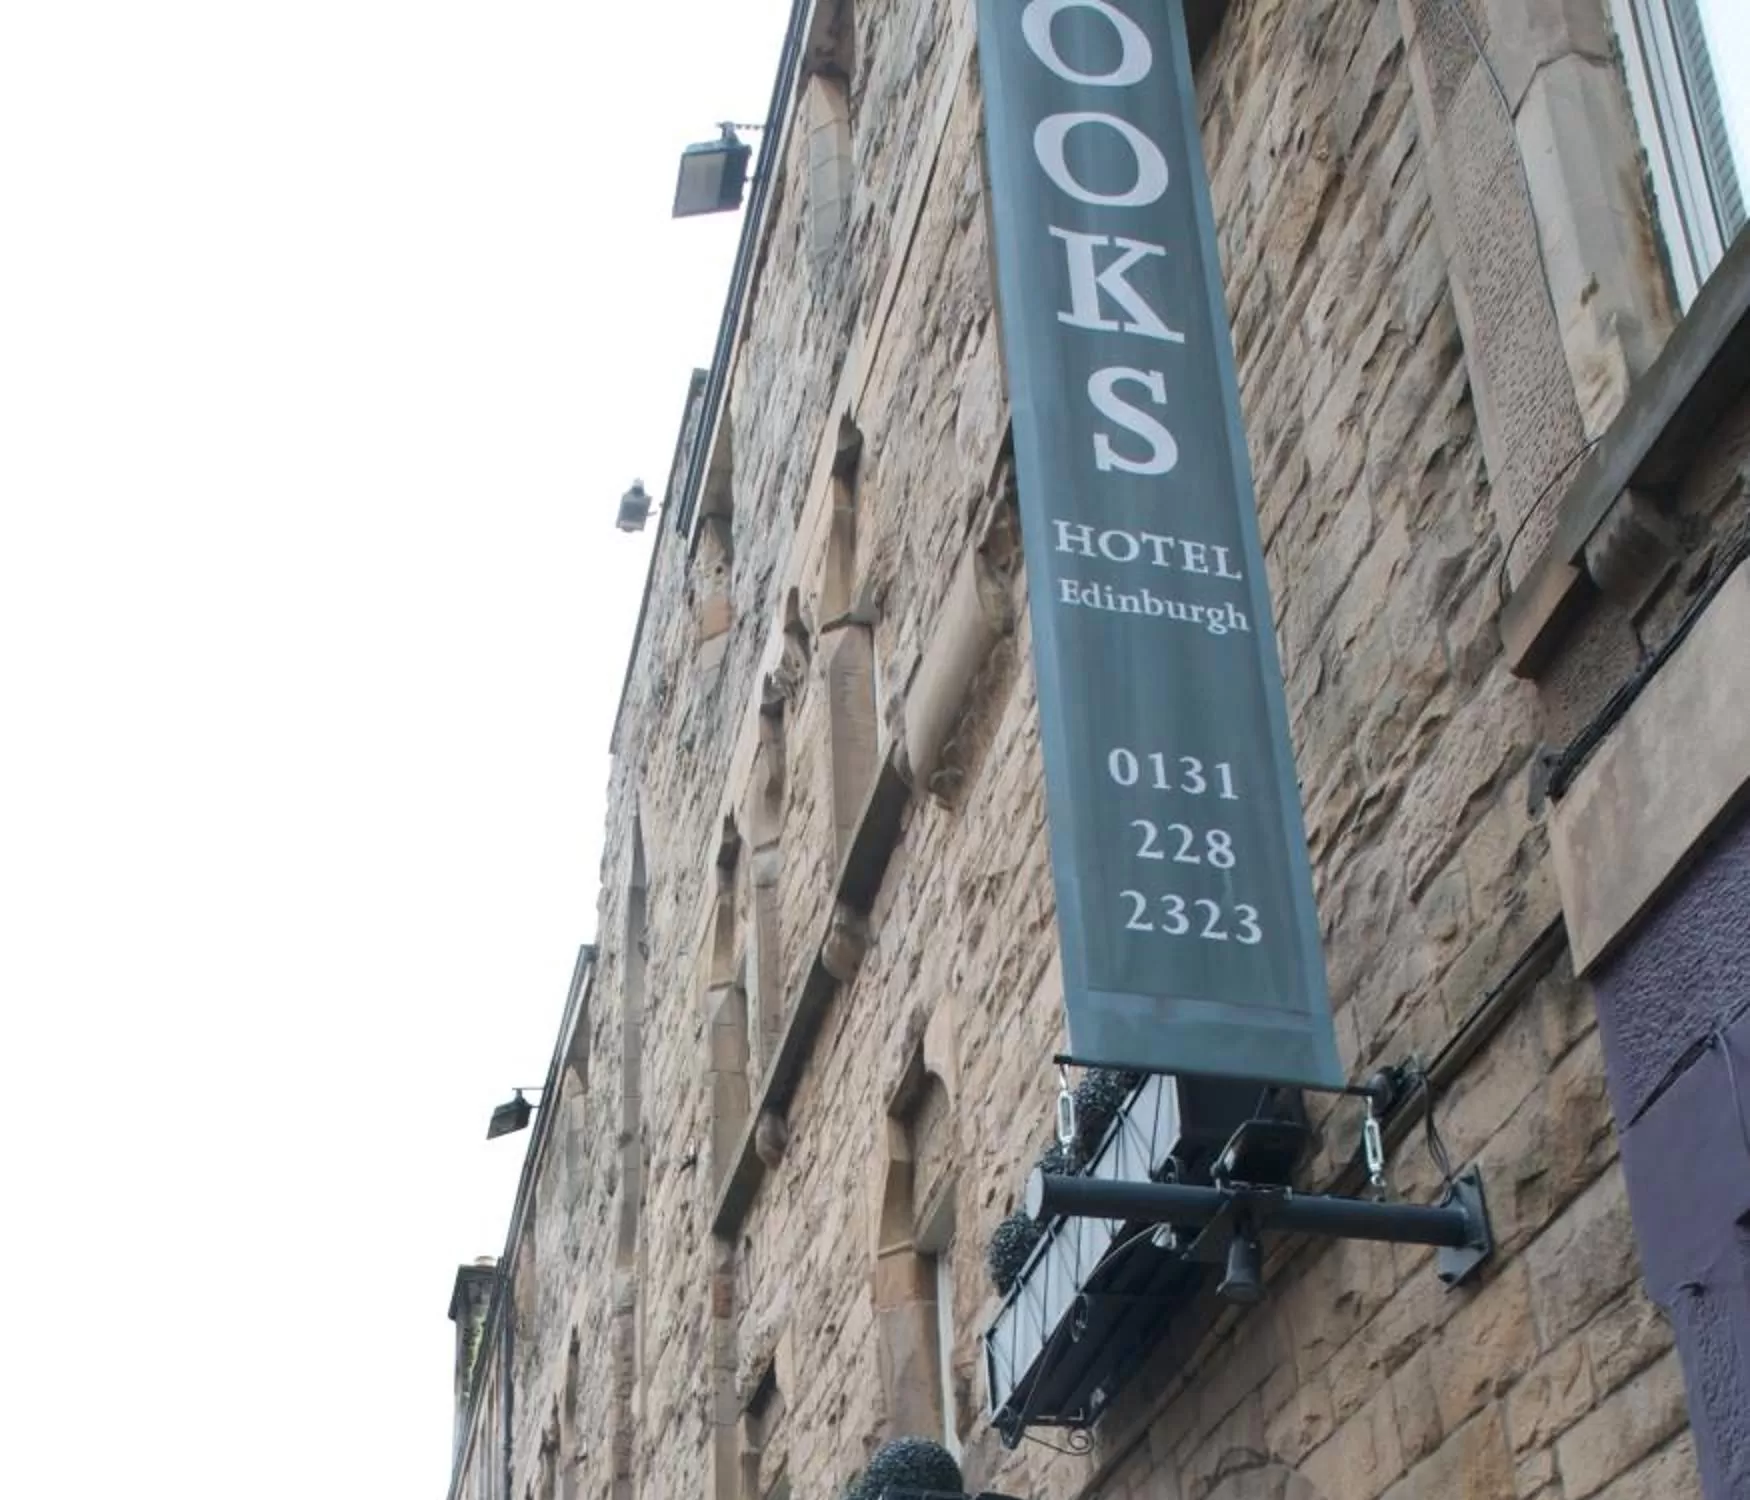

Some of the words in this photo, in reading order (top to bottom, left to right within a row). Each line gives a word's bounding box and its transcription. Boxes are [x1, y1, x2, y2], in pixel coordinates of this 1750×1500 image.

[1053, 519, 1243, 580] HOTEL
[1058, 577, 1249, 635] Edinburgh
[1108, 748, 1239, 800] 0131
[1131, 819, 1236, 869] 228
[1119, 890, 1263, 945] 2323
